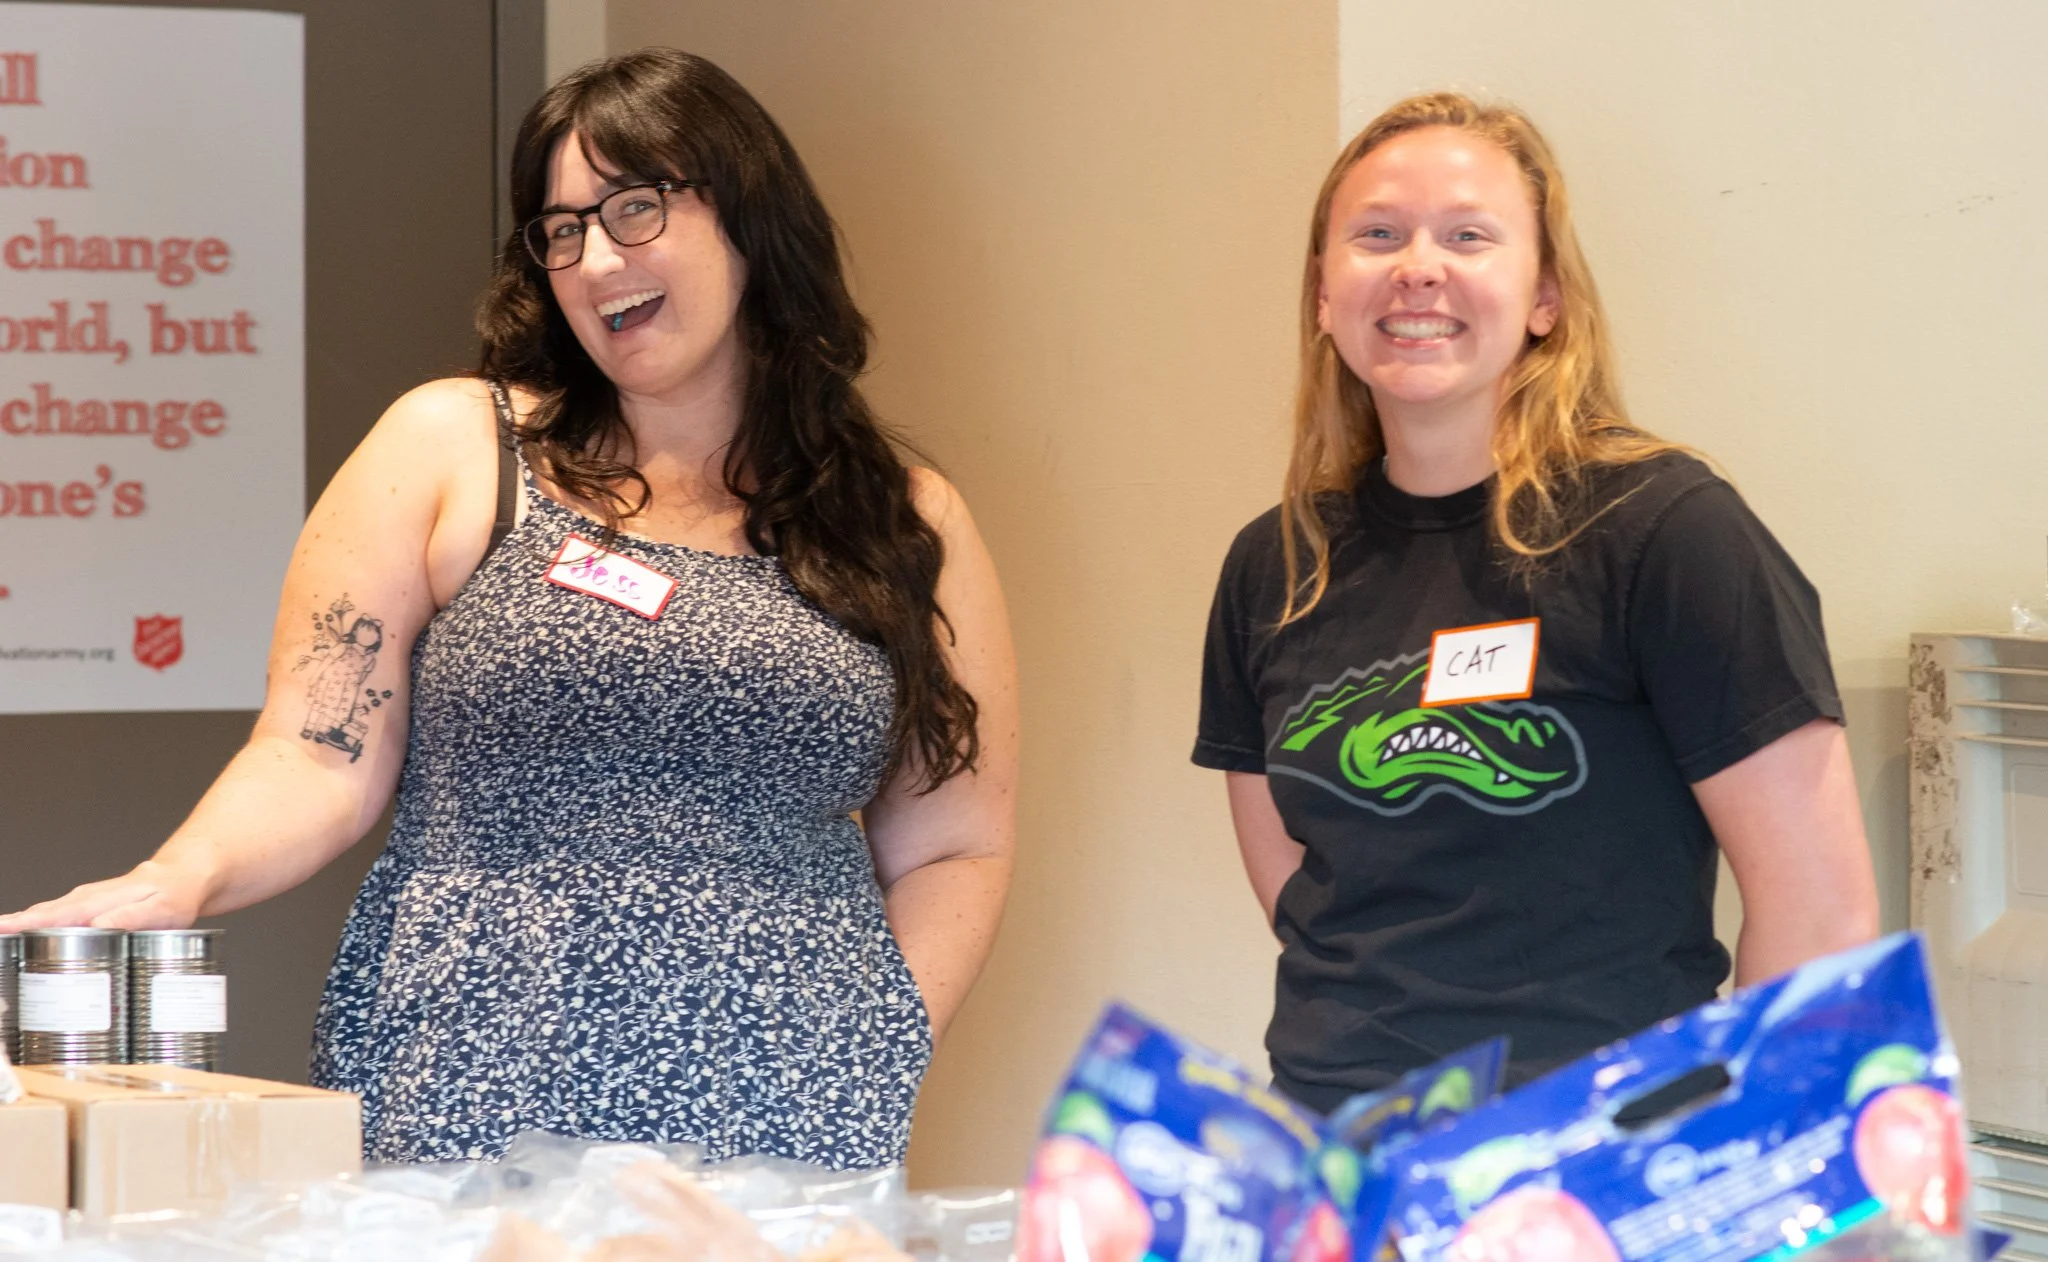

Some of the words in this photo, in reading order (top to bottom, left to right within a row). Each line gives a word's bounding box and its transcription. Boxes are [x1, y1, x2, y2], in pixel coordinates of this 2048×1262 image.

[0, 51, 44, 107] ll
[2, 216, 230, 289] change
[144, 302, 258, 356] but
[0, 382, 226, 451] change
[1446, 643, 1508, 677] CAT
